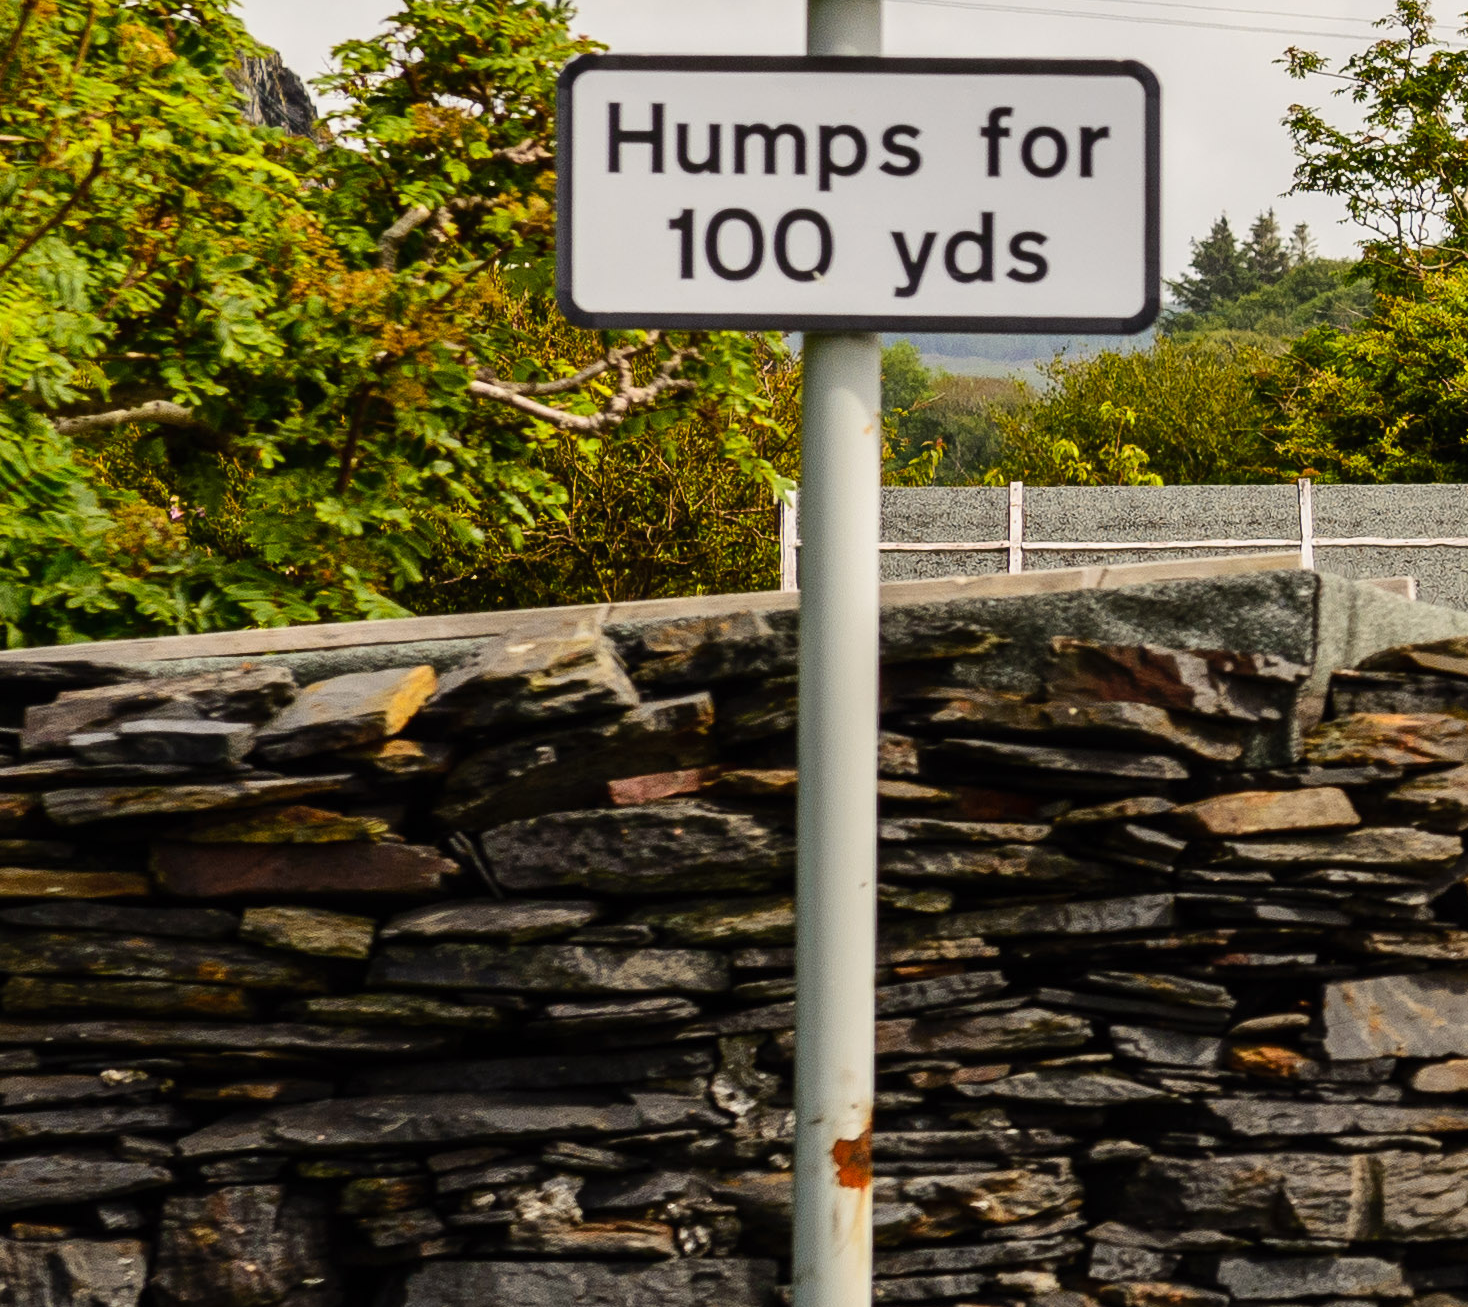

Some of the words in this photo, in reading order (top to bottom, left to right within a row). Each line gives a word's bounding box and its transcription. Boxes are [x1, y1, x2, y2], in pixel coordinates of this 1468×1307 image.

[609, 103, 921, 191] Humps
[981, 107, 1109, 178] for
[669, 208, 833, 282] 100
[891, 212, 1048, 297] yds
